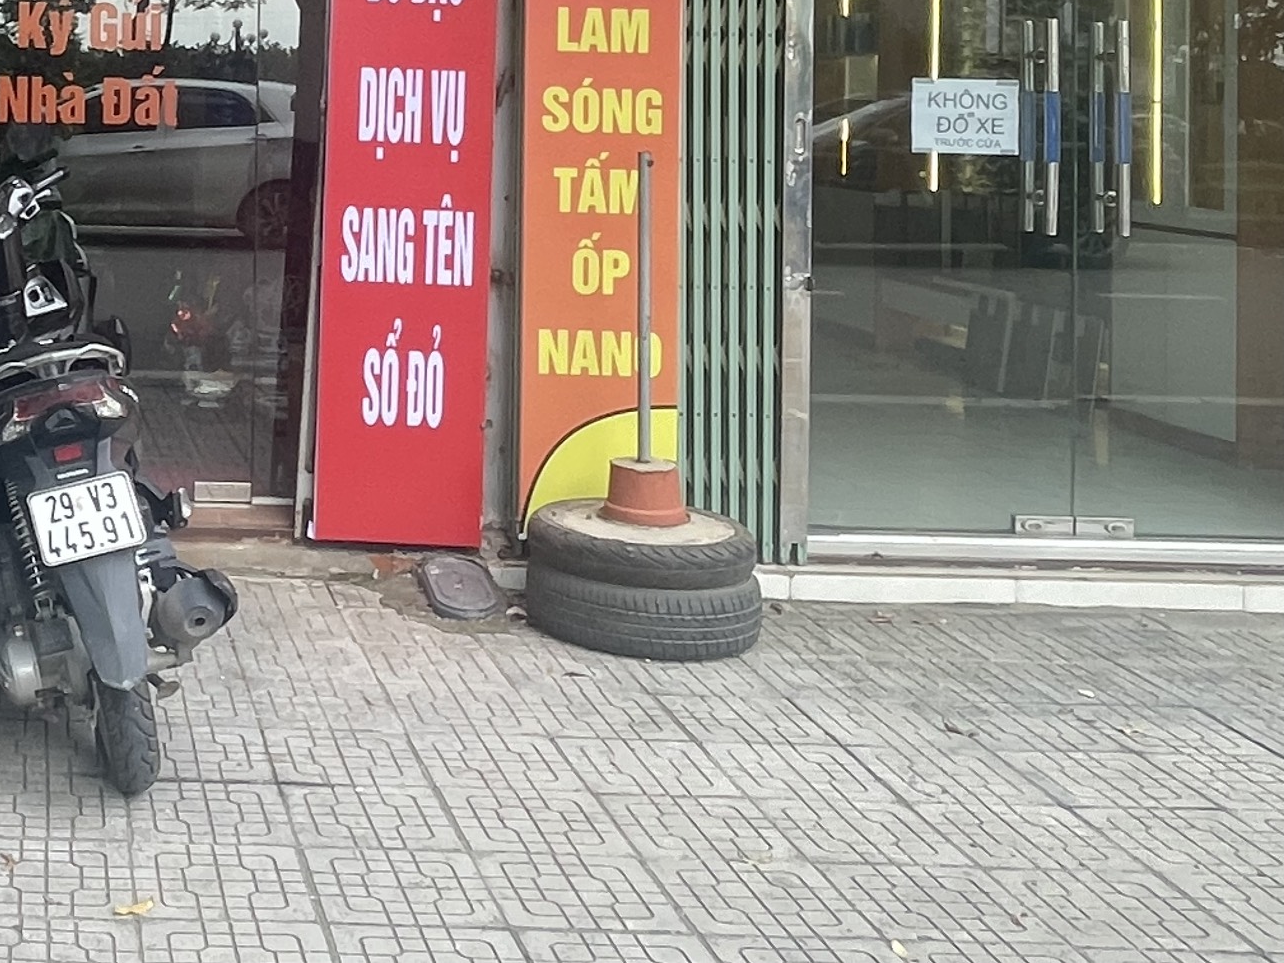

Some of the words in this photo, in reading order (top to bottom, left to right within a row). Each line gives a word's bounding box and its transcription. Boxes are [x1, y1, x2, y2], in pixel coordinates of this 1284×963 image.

[17, 0, 72, 56] Ký
[557, 6, 650, 54] LAM
[358, 67, 424, 160] DỊCH
[431, 70, 466, 163] VỤ
[541, 77, 663, 135] SÓNG
[927, 89, 1008, 110] KHÔNG
[976, 118, 1005, 135] XE
[553, 151, 639, 214] TẤM
[341, 205, 415, 284] SANG
[422, 193, 475, 287] TÊN
[571, 232, 631, 295] ỐP
[362, 317, 403, 427] SỔ
[406, 324, 444, 429] ĐỎ
[538, 328, 663, 378] NANO
[49, 511, 134, 557] 445.91
